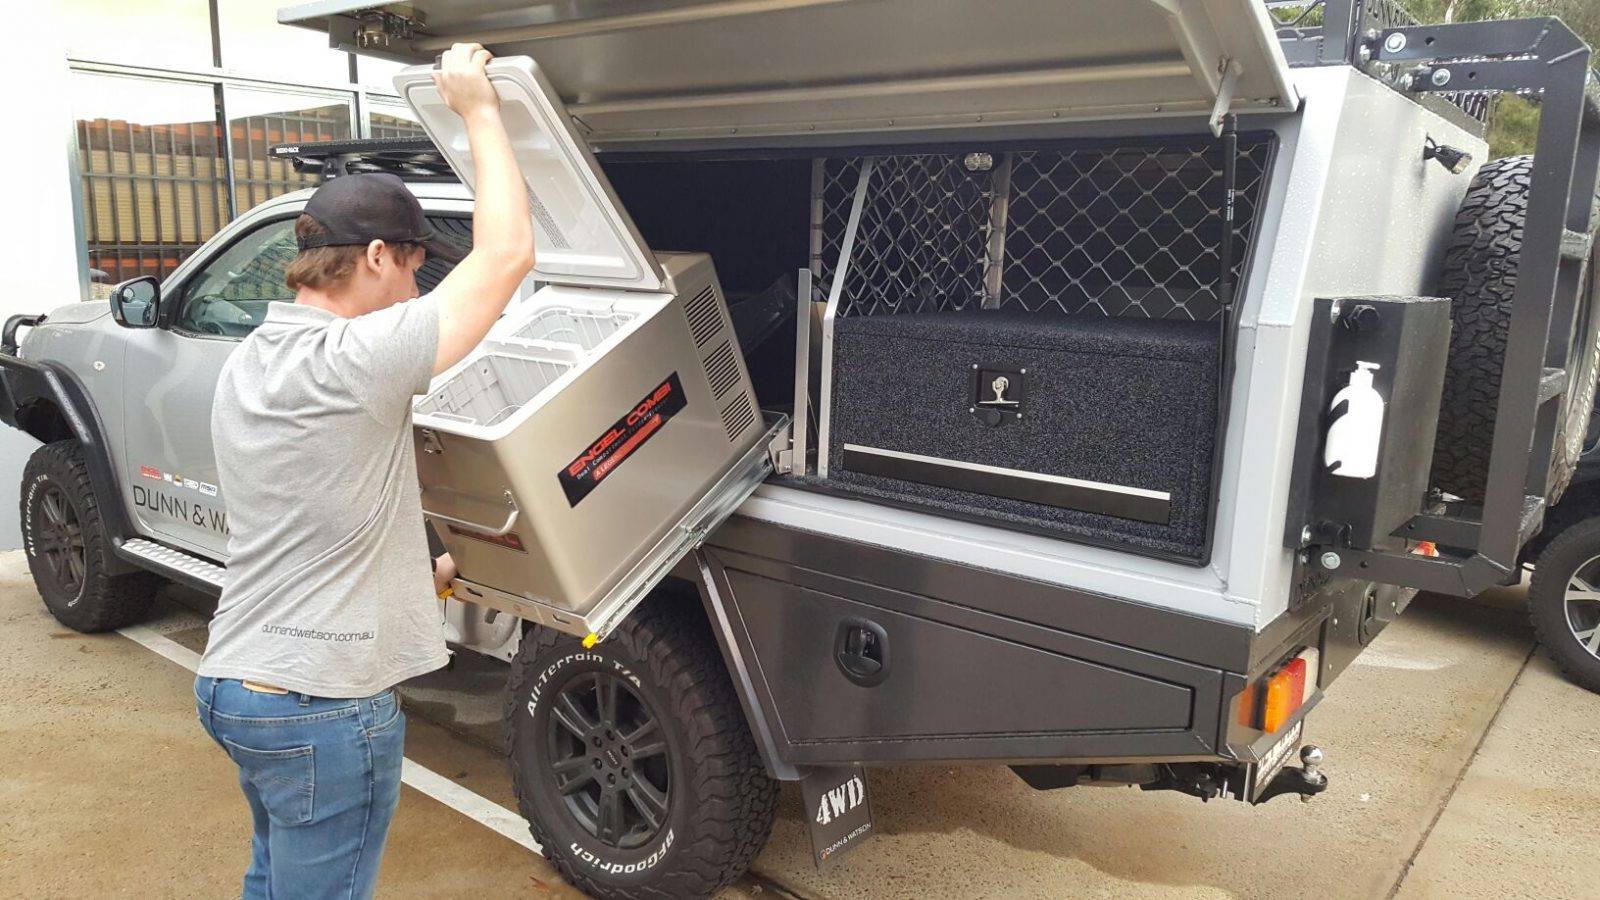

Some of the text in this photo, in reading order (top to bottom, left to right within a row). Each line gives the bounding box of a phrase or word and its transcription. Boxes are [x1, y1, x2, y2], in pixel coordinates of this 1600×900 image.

[569, 427, 626, 477] ENGEL
[627, 382, 672, 426] COMBI
[133, 485, 188, 521] DUNN
[193, 504, 207, 528] &
[527, 651, 641, 718] All-Terrain T/A
[816, 777, 864, 826] 4WD
[570, 827, 675, 875] BFGoodrich
[826, 839, 844, 856] DUNN
[848, 822, 871, 840] WATSON
